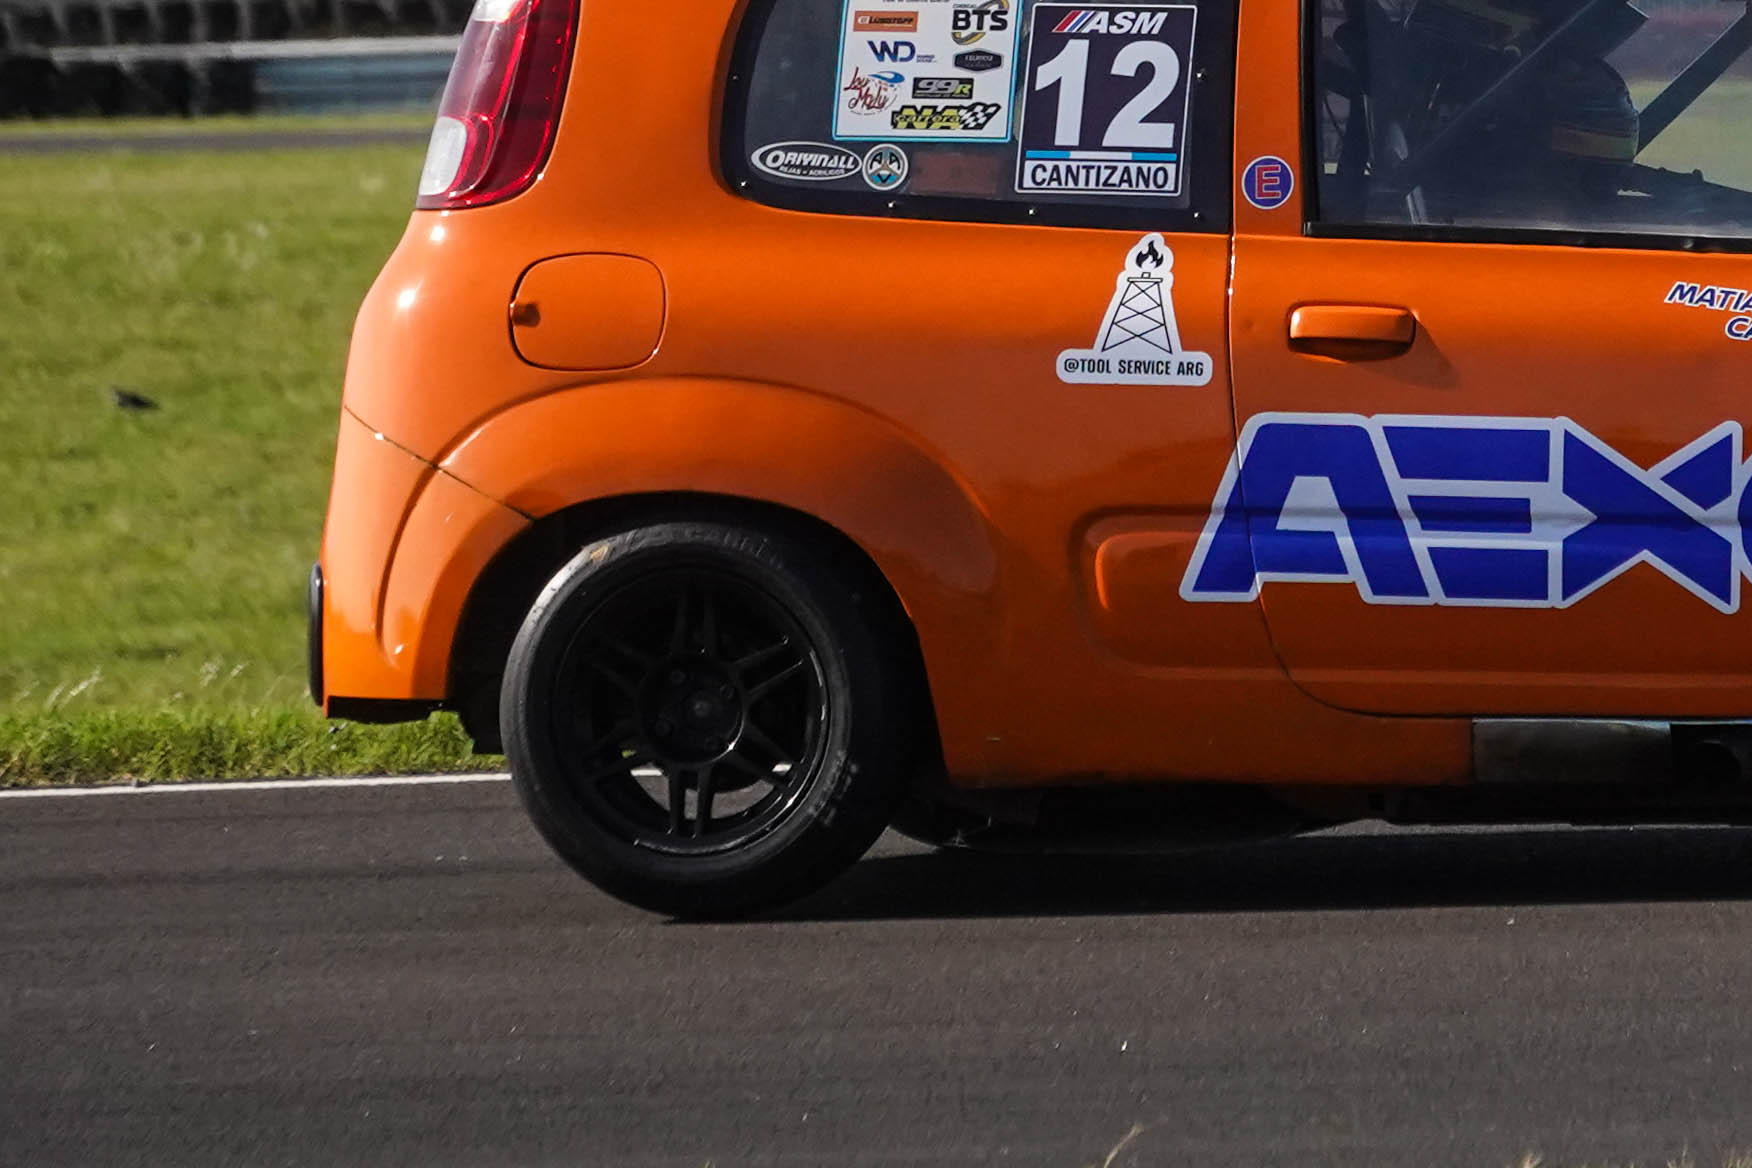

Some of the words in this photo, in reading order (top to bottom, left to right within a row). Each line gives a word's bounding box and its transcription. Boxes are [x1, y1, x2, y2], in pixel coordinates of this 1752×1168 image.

[952, 9, 1009, 31] BTS
[1080, 10, 1169, 35] ASM
[867, 40, 917, 63] WD
[1034, 38, 1181, 149] 12
[1030, 164, 1169, 190] CANTIZANO
[1254, 165, 1281, 200] E
[1063, 358, 1112, 374] @TOOL
[1117, 359, 1171, 376] SERVICE
[1176, 361, 1204, 377] ARG
